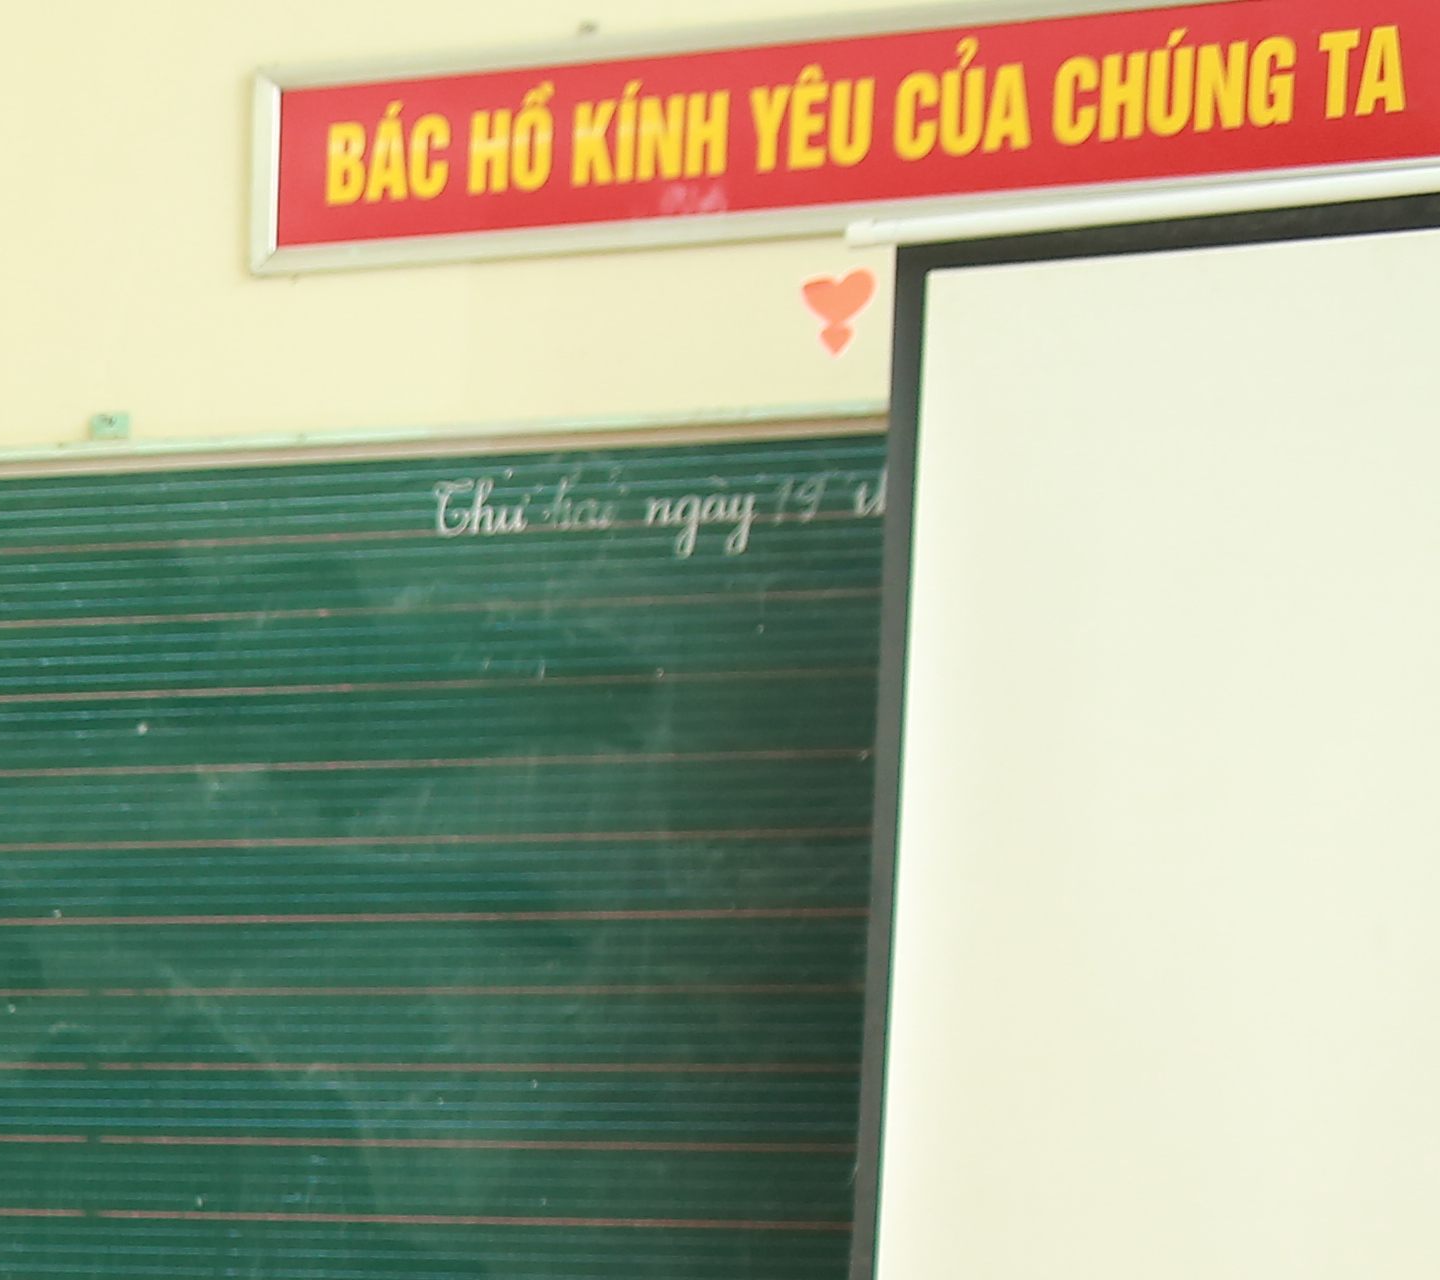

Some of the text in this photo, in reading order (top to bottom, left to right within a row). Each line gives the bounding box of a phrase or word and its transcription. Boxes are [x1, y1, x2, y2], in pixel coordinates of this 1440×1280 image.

[326, 101, 451, 205] BÁC
[572, 80, 729, 187] KÍNH
[749, 64, 876, 168] YÊU
[893, 36, 1032, 161] CỦA
[1052, 28, 1297, 146] CHÚNG
[1319, 25, 1406, 119] TA
